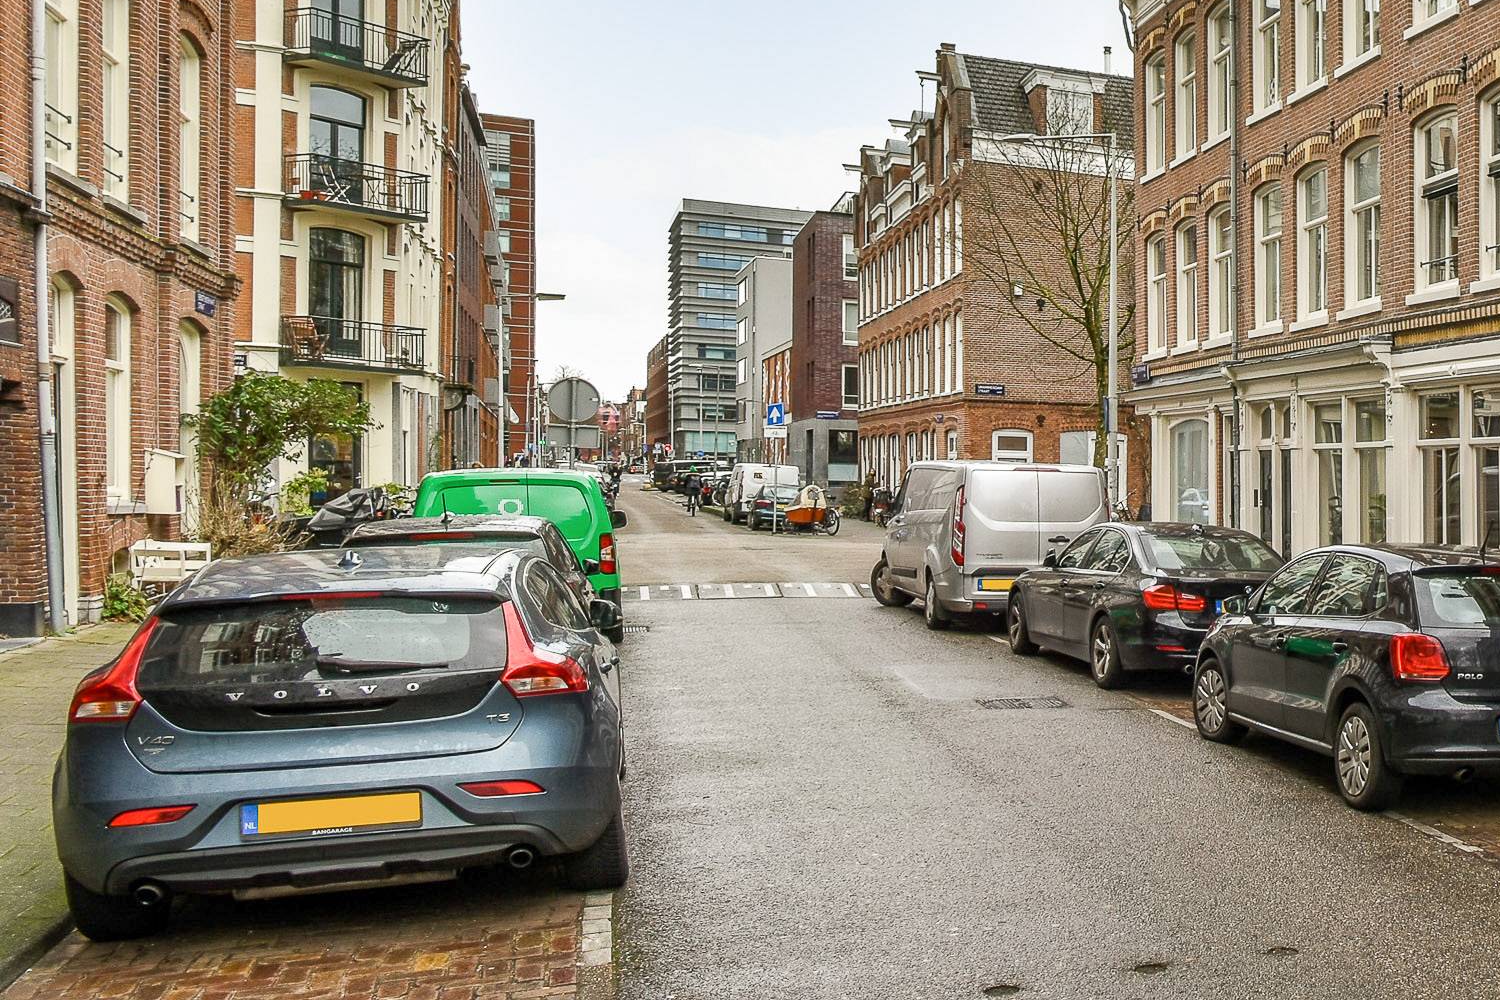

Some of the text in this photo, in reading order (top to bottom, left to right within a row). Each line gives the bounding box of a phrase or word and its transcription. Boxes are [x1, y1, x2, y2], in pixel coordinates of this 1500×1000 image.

[225, 682, 420, 701] VOLVO
[486, 713, 510, 722] T3
[138, 735, 175, 745] V40
[244, 822, 257, 830] NL
